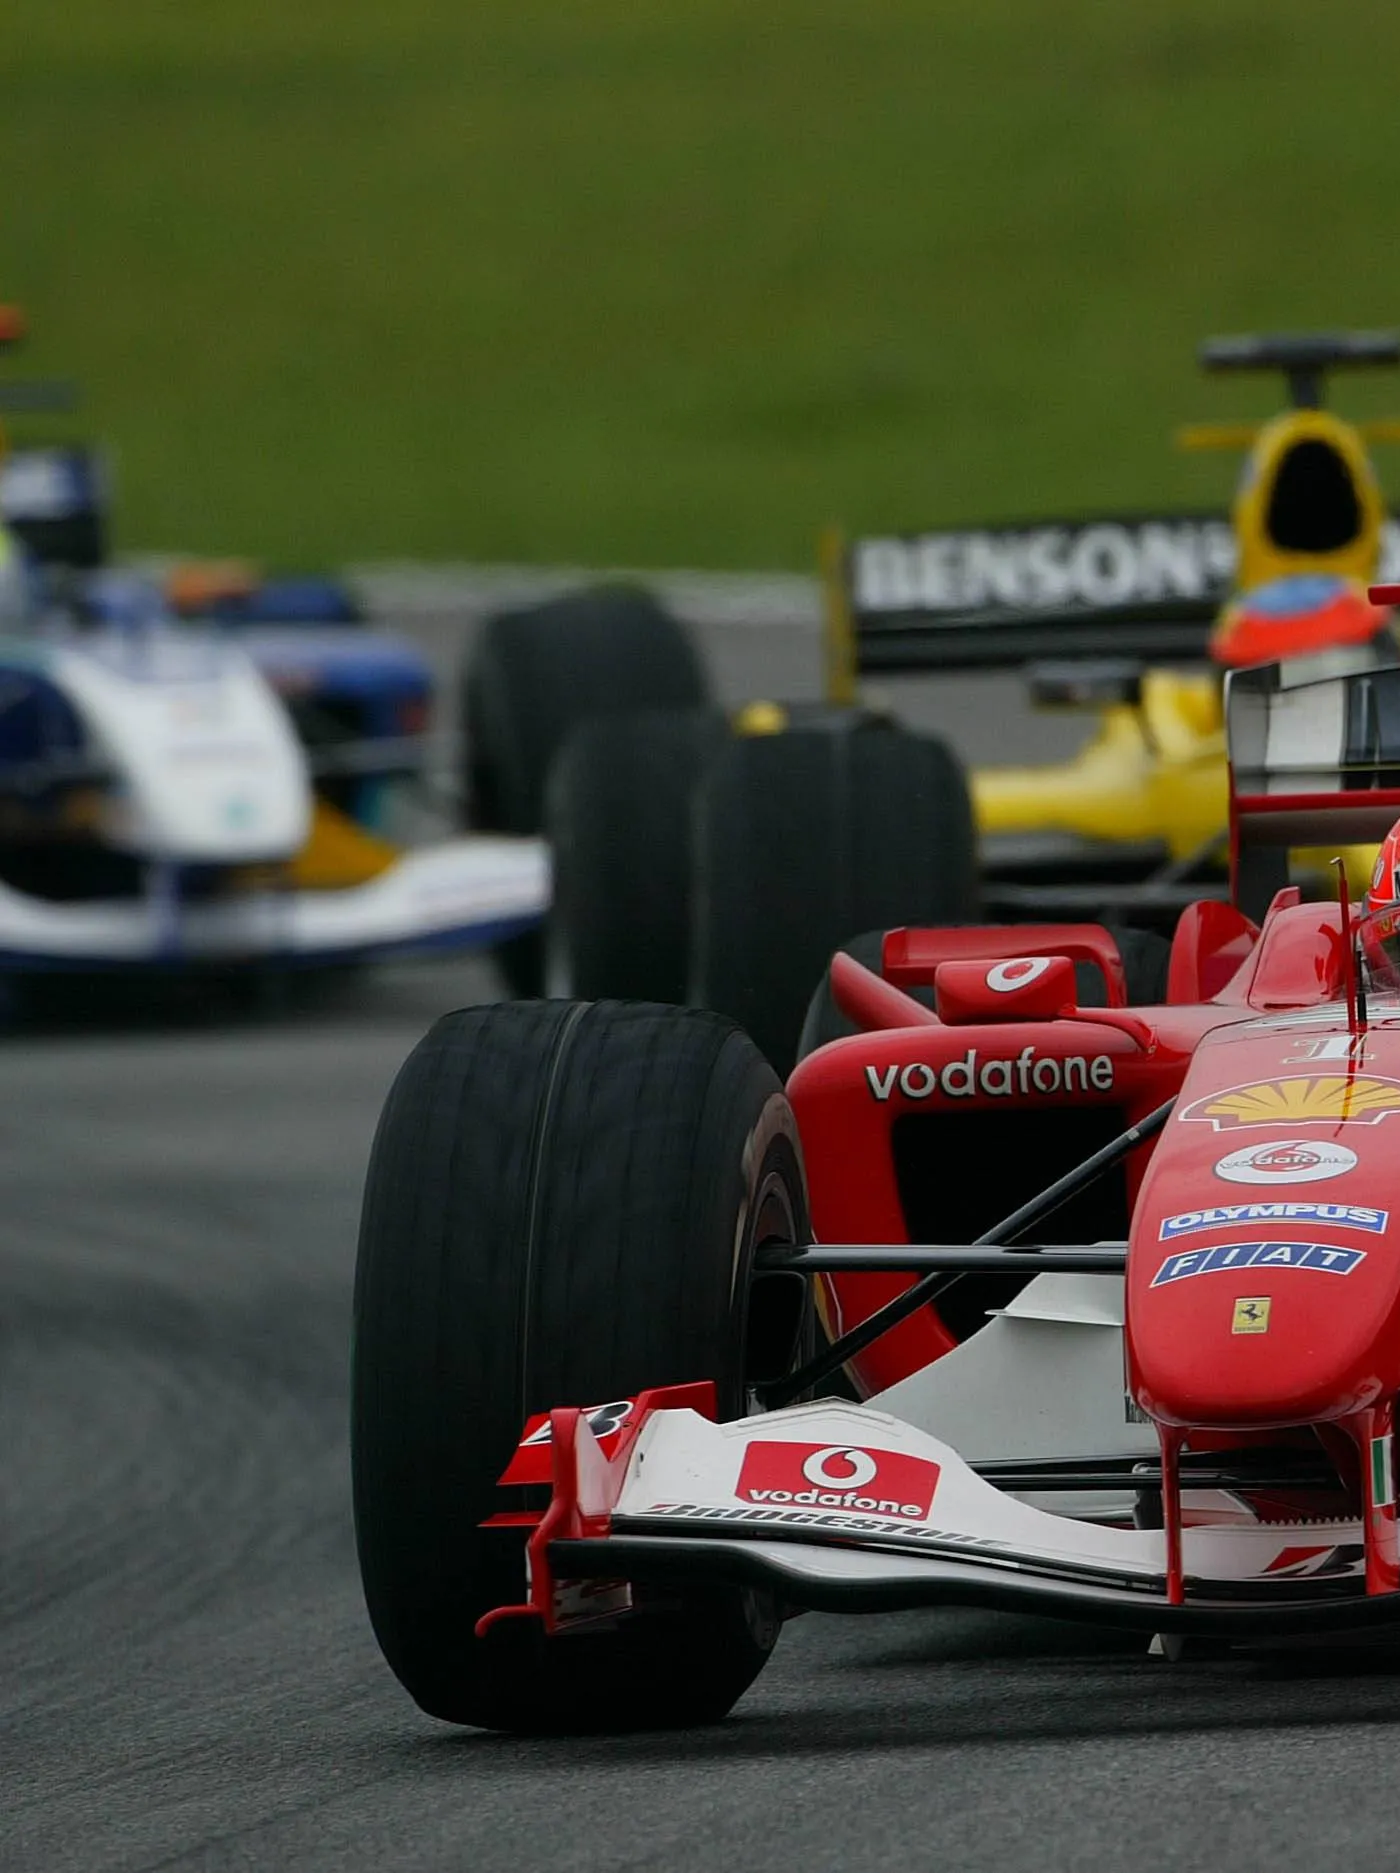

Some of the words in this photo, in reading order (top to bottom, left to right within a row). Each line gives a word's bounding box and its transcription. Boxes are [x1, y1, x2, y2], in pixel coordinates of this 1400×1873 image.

[853, 520, 1196, 610] BENSON
[866, 1045, 1114, 1102] vodafone
[1167, 1204, 1379, 1230] OLYMPUS
[1169, 1246, 1349, 1277] FIAT
[748, 1487, 924, 1517] vodafone
